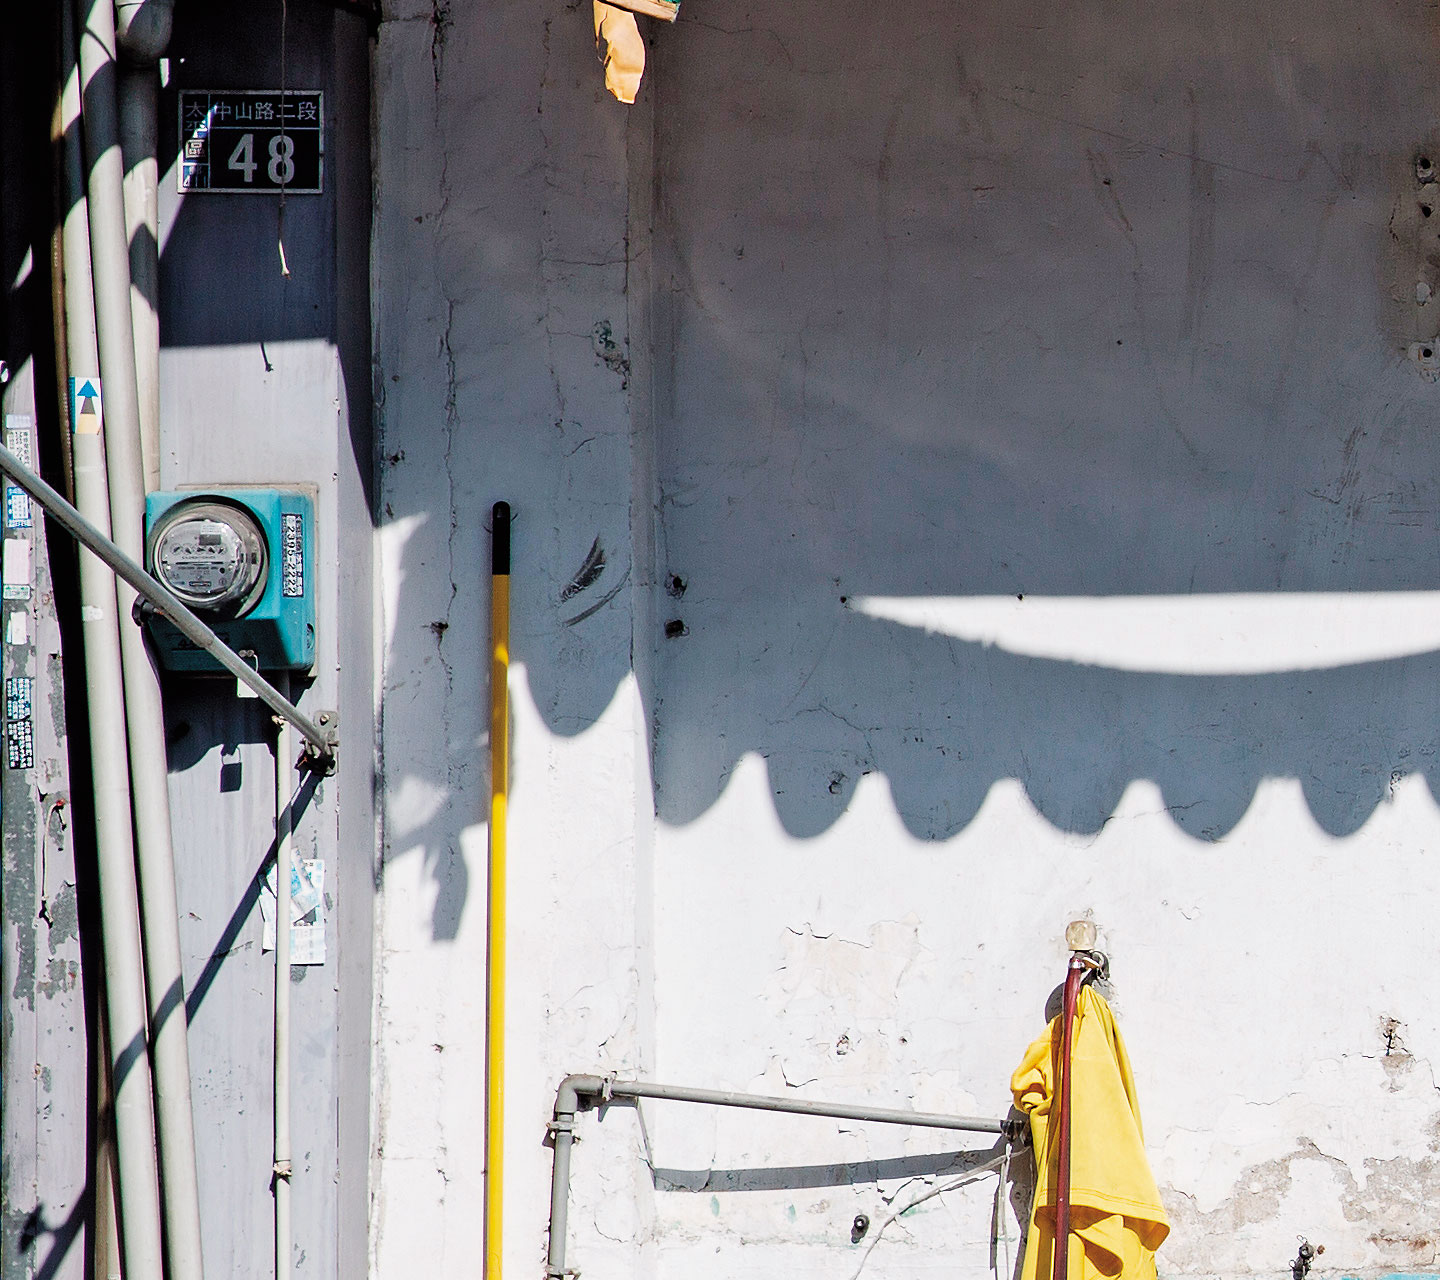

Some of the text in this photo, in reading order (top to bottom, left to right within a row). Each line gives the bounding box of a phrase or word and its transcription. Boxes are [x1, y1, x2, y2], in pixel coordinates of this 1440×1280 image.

[214, 101, 317, 120] 中山路二段
[228, 133, 294, 184] 48
